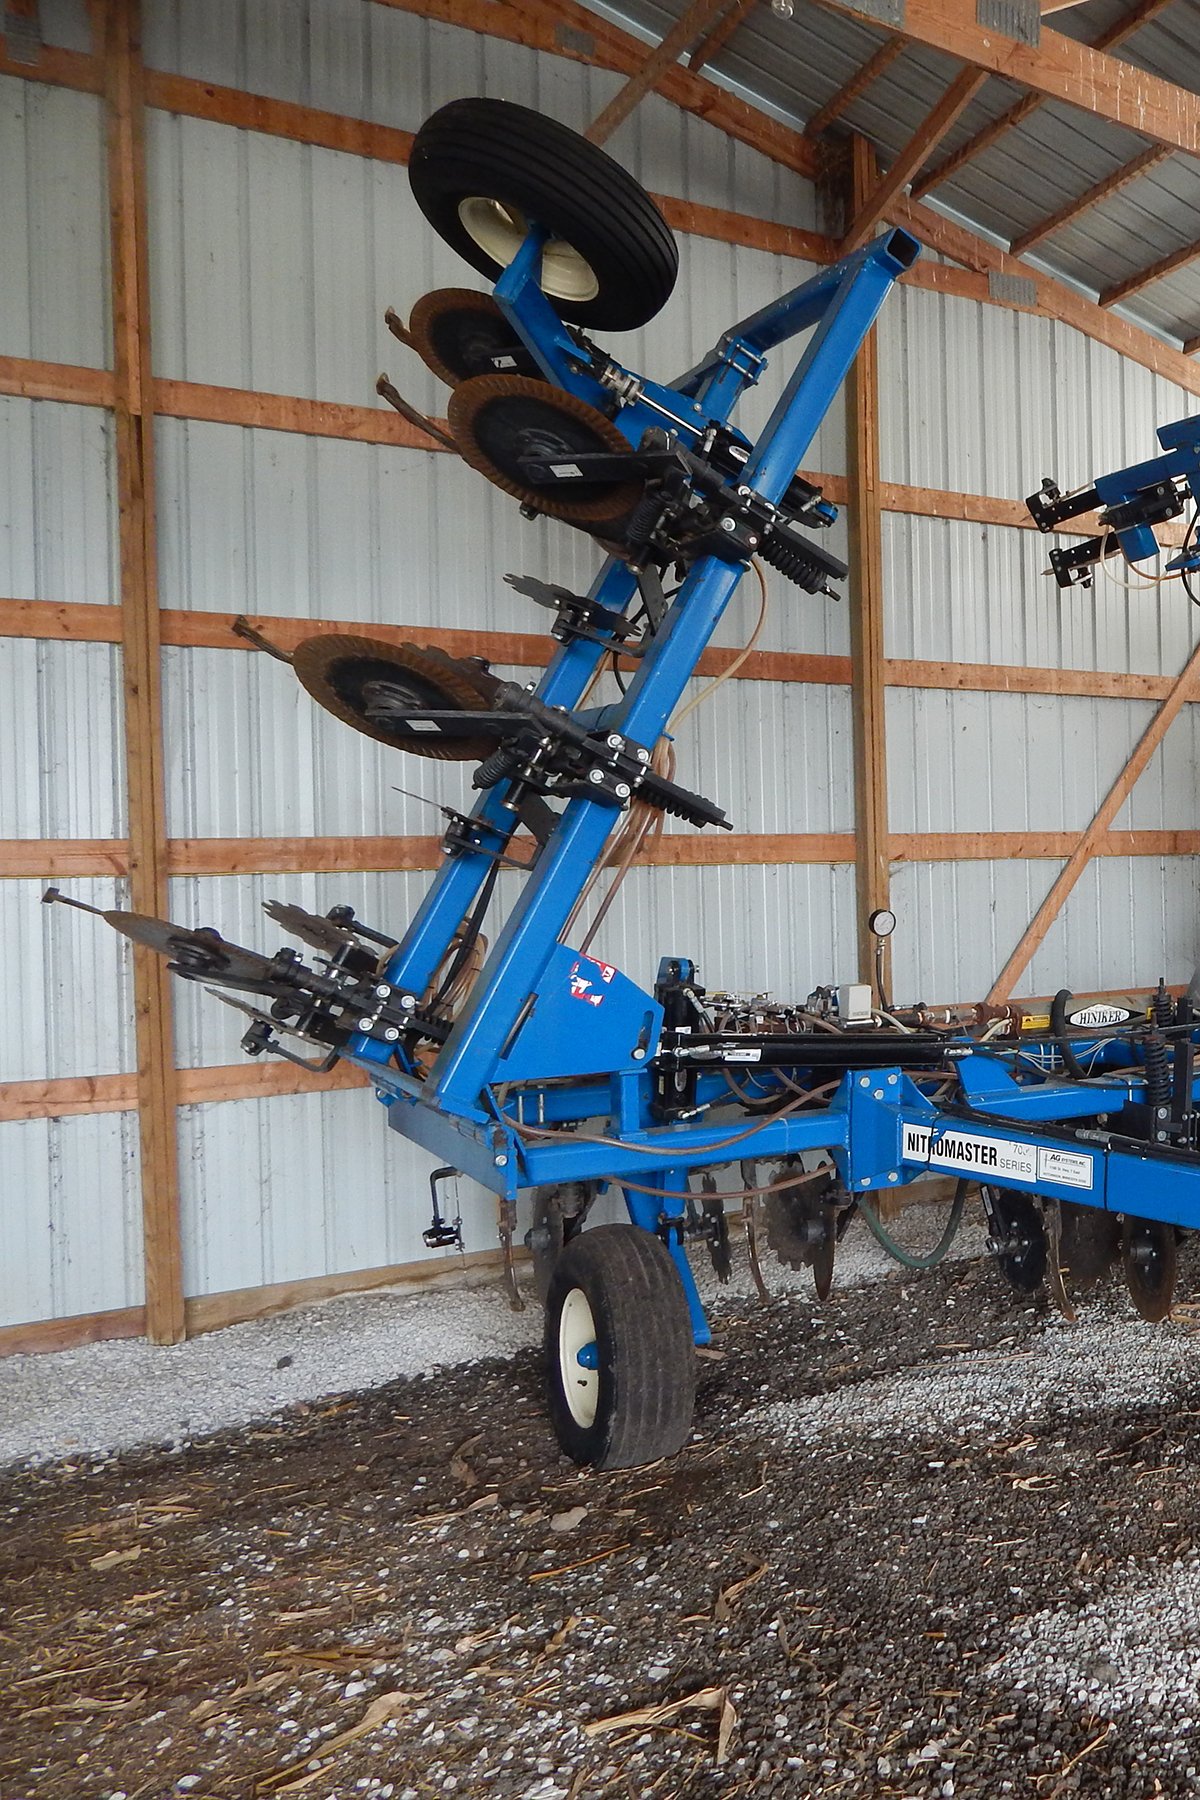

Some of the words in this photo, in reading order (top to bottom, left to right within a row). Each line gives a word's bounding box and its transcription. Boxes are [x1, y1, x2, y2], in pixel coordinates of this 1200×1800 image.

[1080, 1010, 1122, 1024] HINIKER
[1050, 1154, 1061, 1162] AG
[1000, 1158, 1032, 1173] SERIES
